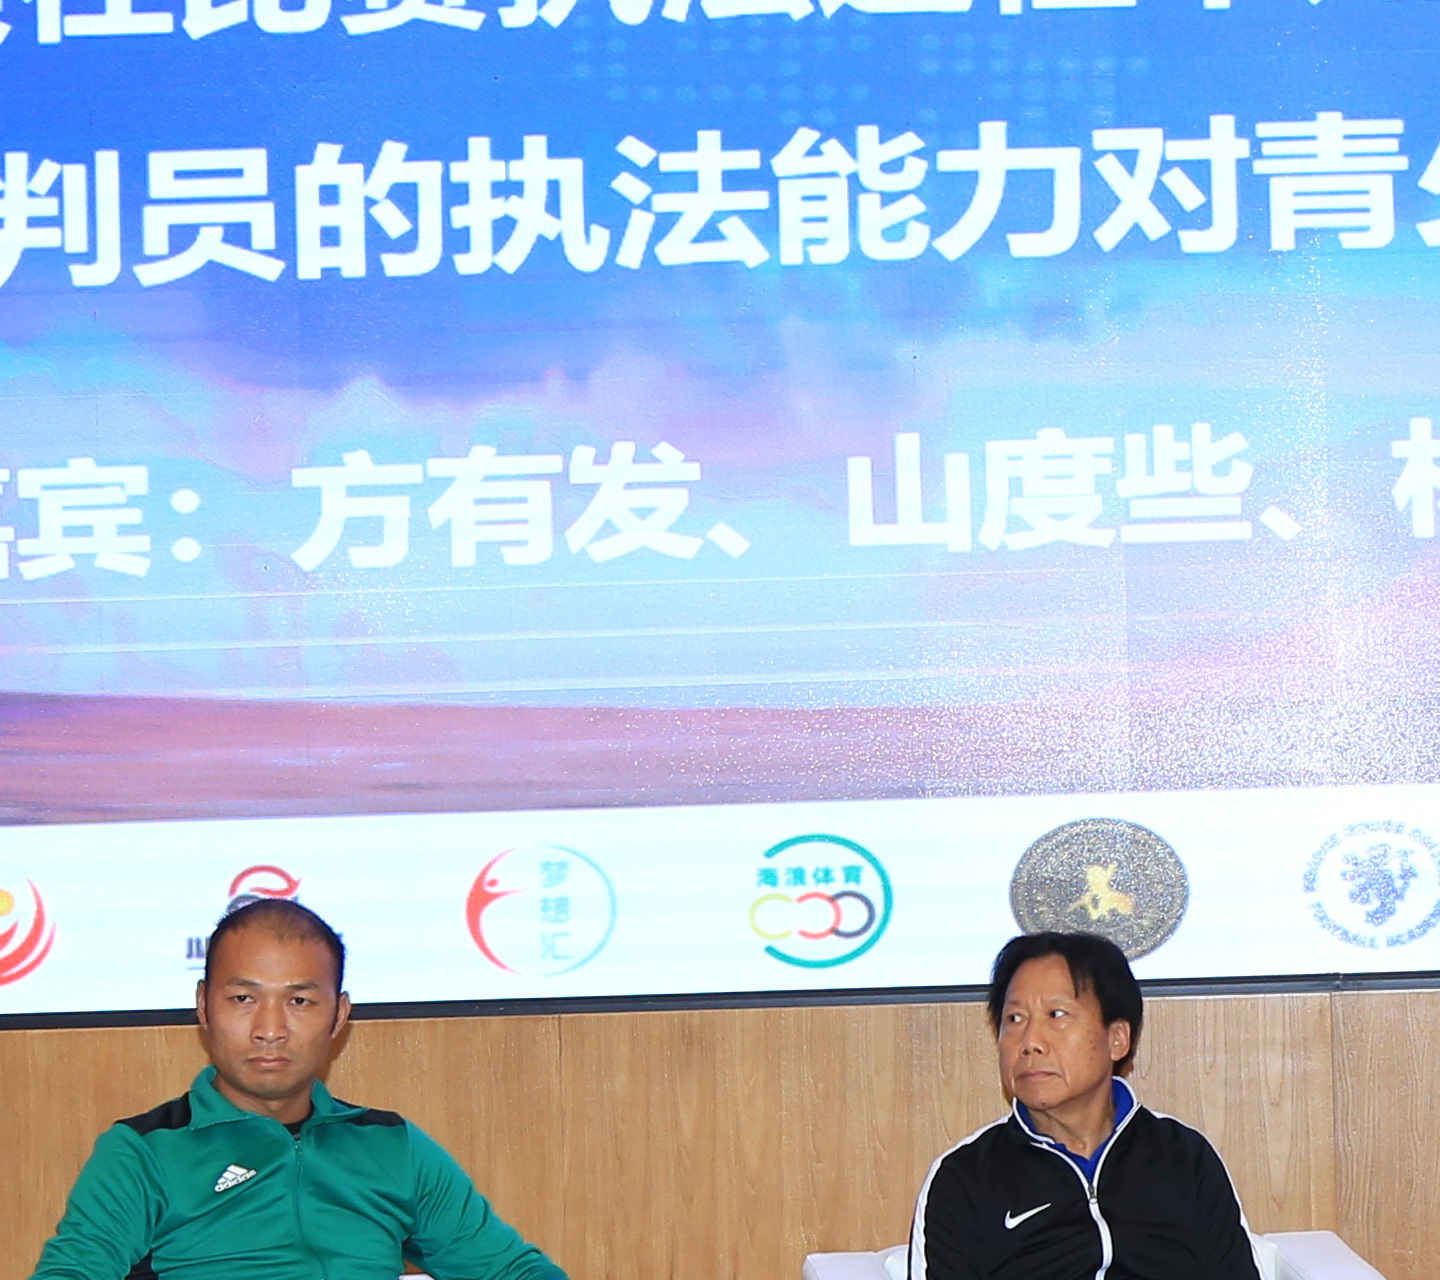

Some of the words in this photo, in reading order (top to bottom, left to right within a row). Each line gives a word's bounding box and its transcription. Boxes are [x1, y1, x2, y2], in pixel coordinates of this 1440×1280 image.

[756, 863, 864, 888] 海浪体育
[539, 859, 573, 960] 梦想汇
[214, 1169, 257, 1192] adidas
